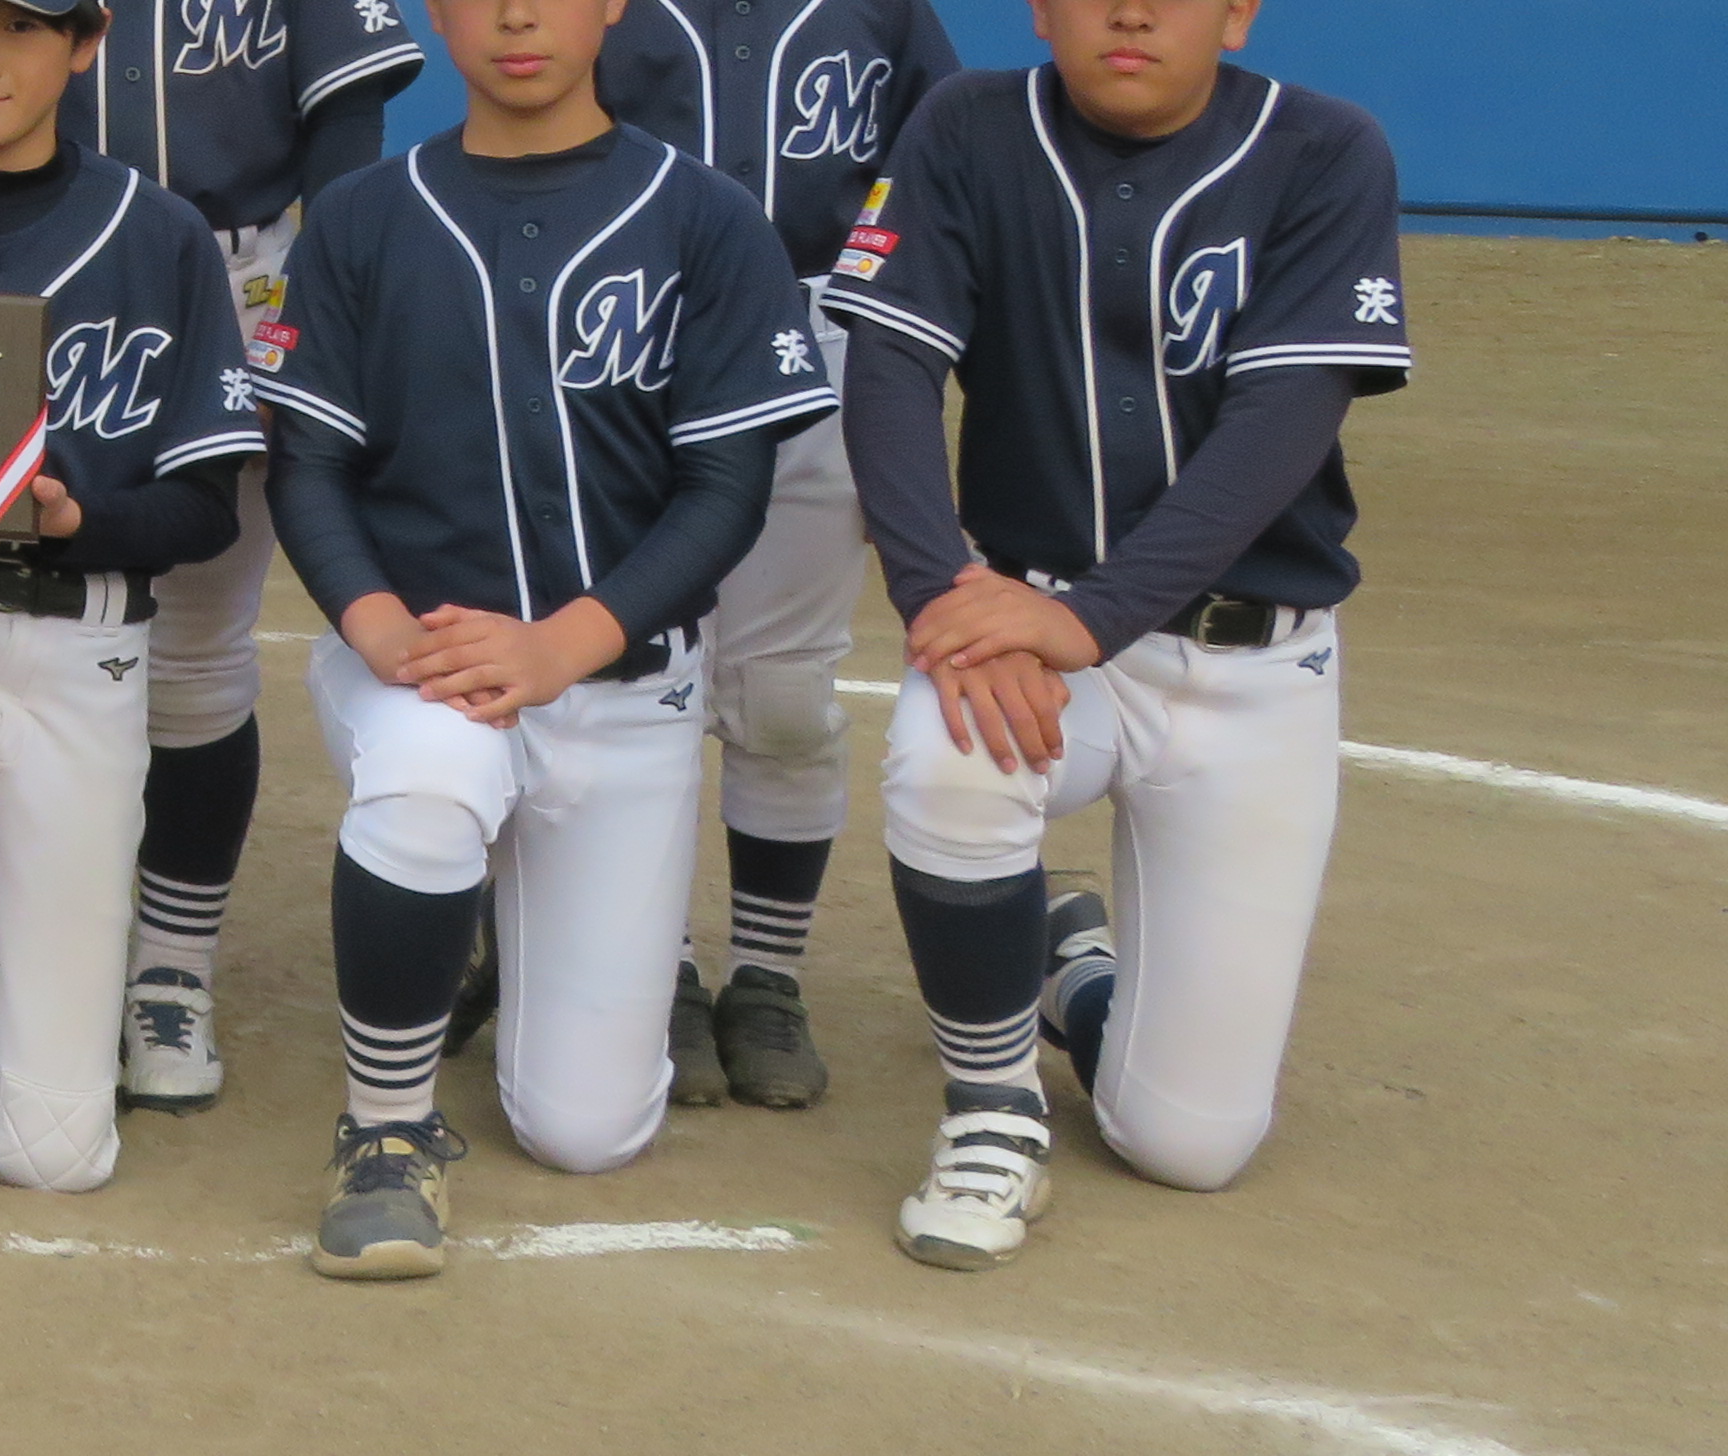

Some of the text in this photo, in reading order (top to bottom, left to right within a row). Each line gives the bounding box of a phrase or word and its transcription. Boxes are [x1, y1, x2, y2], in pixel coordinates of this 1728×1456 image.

[780, 50, 892, 163] M
[559, 268, 683, 392] M
[771, 330, 815, 375] 茨
[1354, 277, 1399, 325] 茨
[45, 316, 172, 439] M
